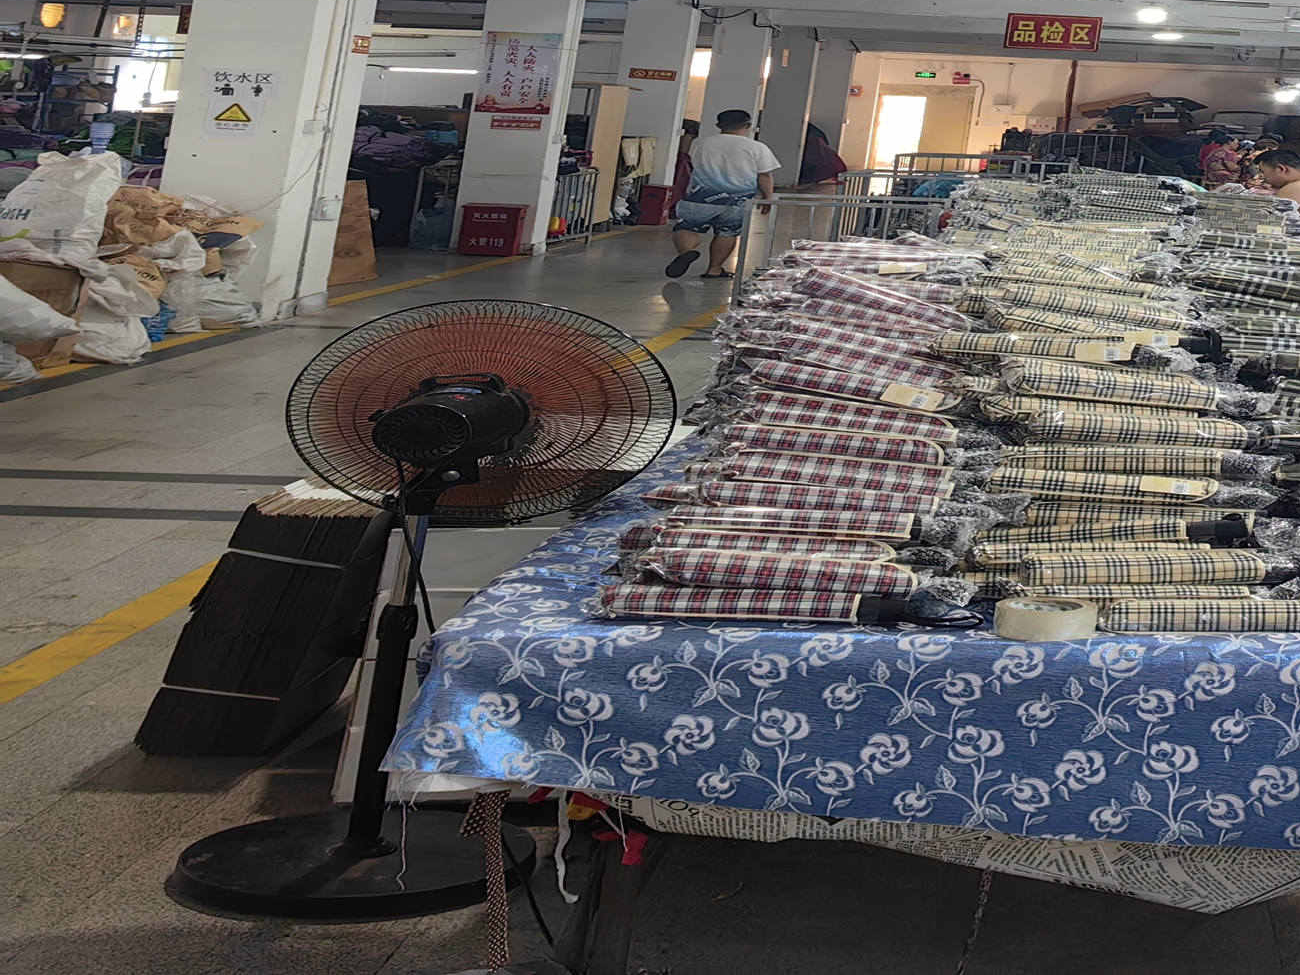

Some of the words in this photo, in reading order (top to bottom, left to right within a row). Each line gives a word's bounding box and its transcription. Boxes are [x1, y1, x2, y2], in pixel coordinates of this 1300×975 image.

[1012, 20, 1093, 45] 品检区
[214, 71, 273, 85] 饮水区
